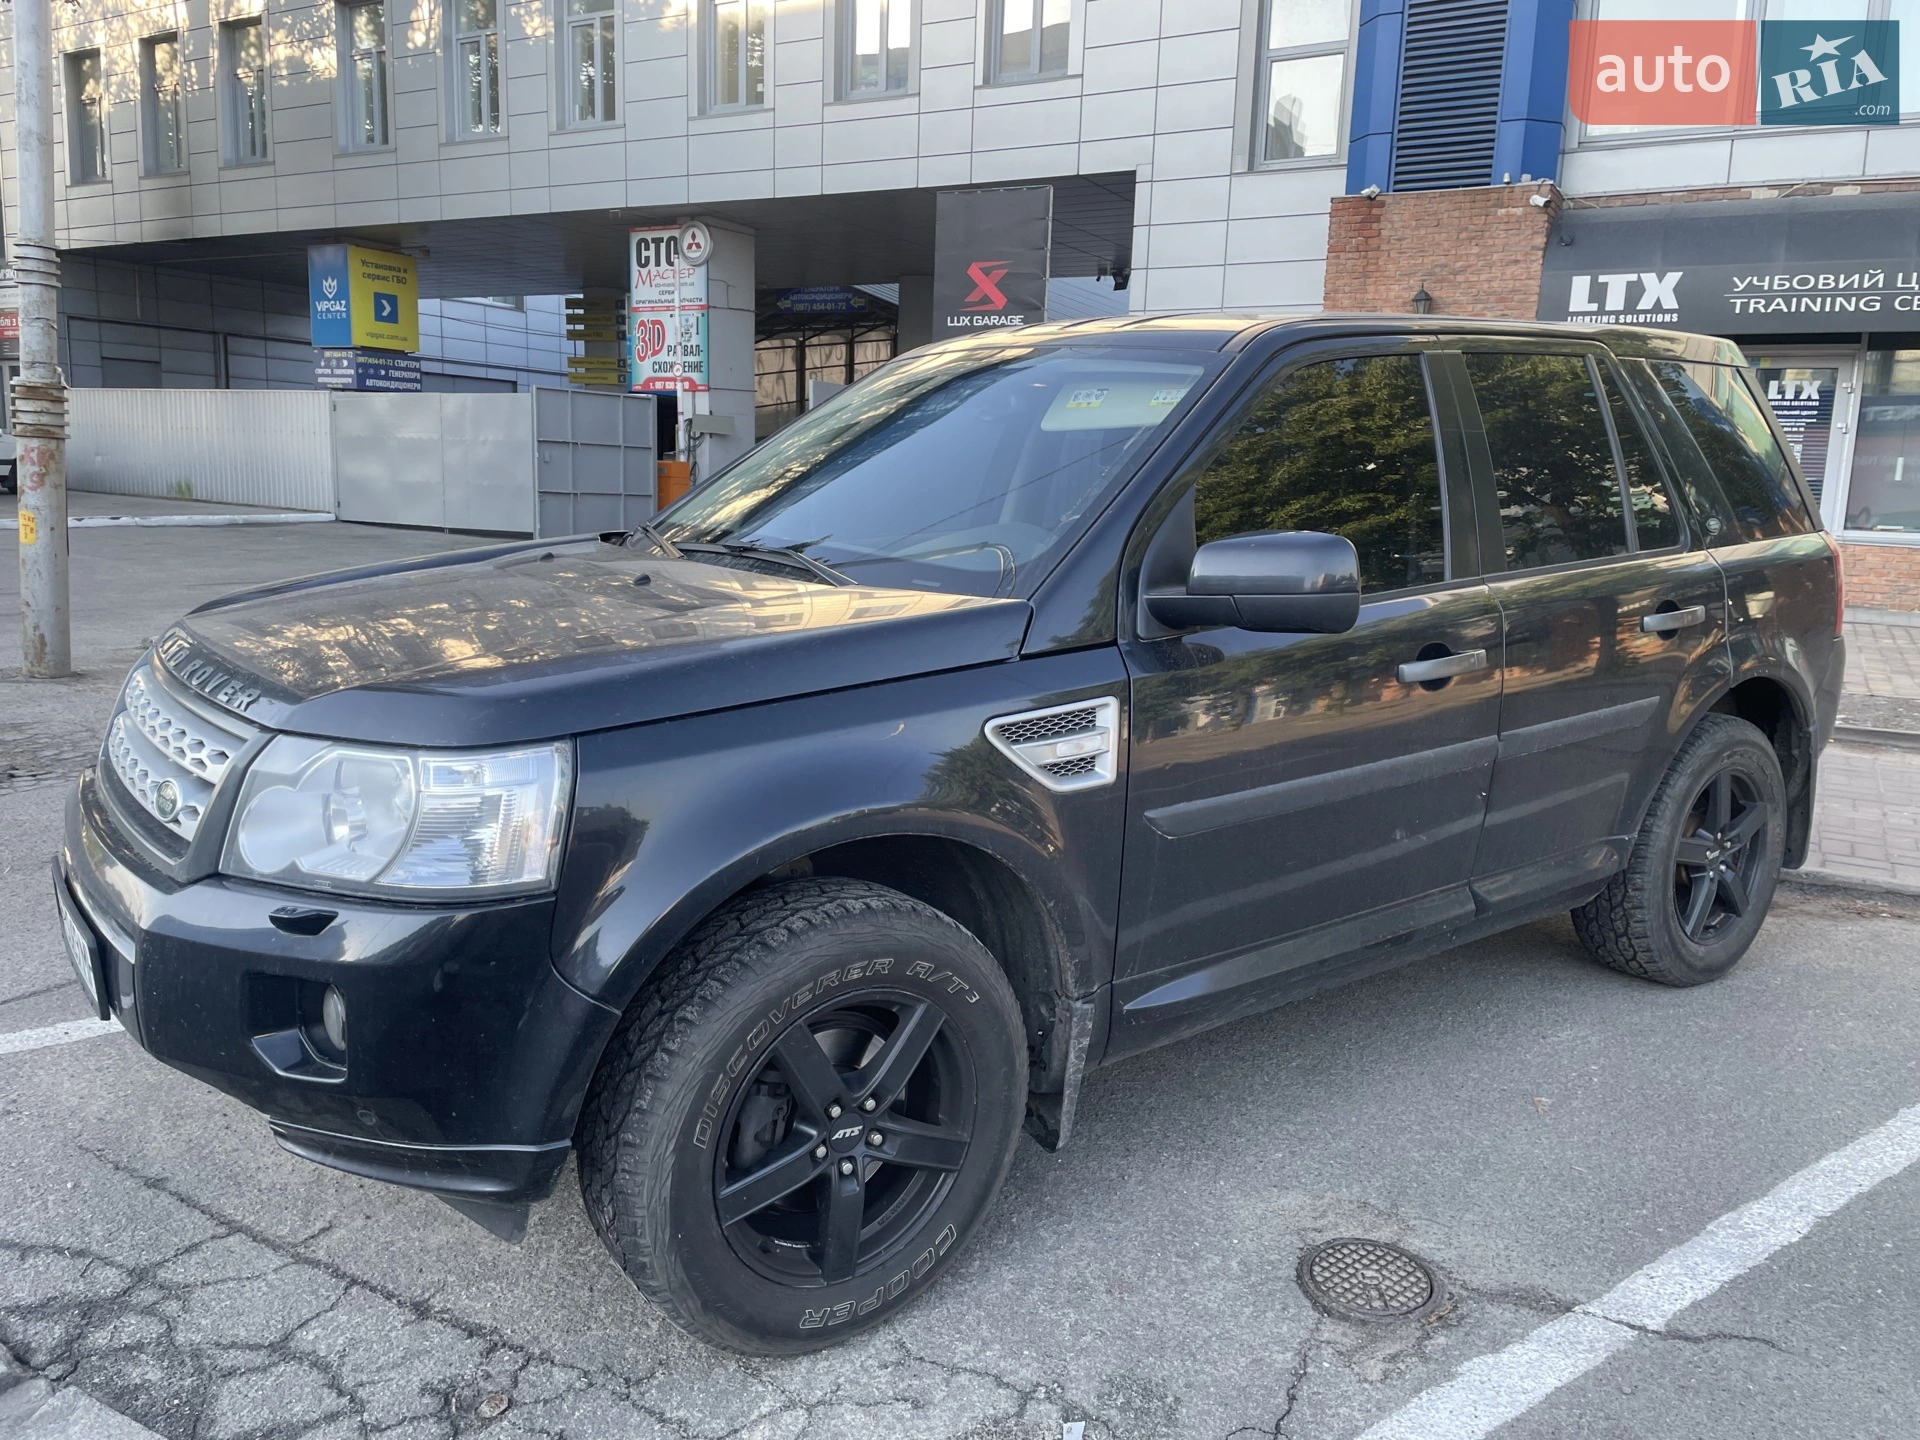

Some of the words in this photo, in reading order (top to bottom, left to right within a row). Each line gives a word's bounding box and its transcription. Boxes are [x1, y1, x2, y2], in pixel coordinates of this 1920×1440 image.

[360, 258, 402, 273] Установка
[362, 271, 390, 282] сервис
[391, 275, 407, 285] ГБО
[1732, 269, 1885, 292] УЧБОВИЙ
[1568, 271, 1684, 312] LTX
[1729, 296, 1882, 314] TRAINING
[317, 312, 347, 320] CENTER
[947, 316, 971, 326] LUX
[973, 315, 1024, 326] GARAGE
[1618, 313, 1679, 323] SOLUTIONS
[365, 331, 408, 342] vipgaz.com.ua
[634, 318, 666, 363] 3D
[394, 359, 420, 369] СТАРТЕРИ
[388, 370, 420, 380] ГЕНЕРАТОРИ
[1767, 380, 1822, 400] LTX
[181, 659, 261, 712] ROVER
[694, 958, 895, 1149] DISCOVERER
[831, 1125, 863, 1141] ATS
[799, 1223, 957, 1329] COOPER
